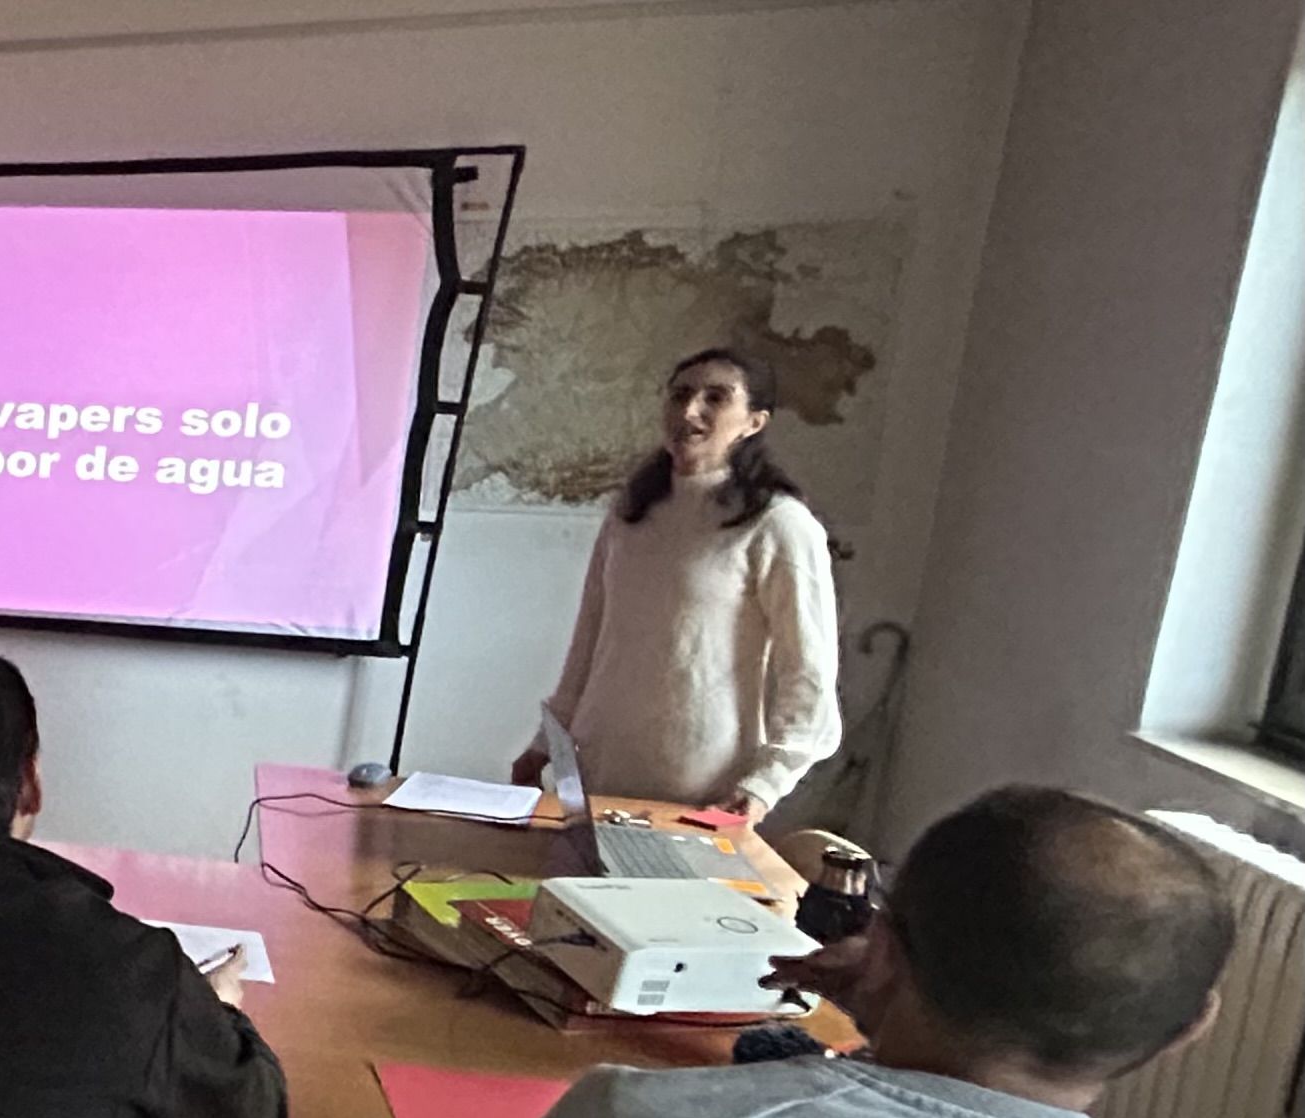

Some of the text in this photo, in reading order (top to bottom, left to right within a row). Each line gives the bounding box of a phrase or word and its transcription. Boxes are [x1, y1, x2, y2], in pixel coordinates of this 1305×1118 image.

[179, 402, 292, 440] solo
[74, 445, 140, 482] de
[155, 456, 286, 495] agua
